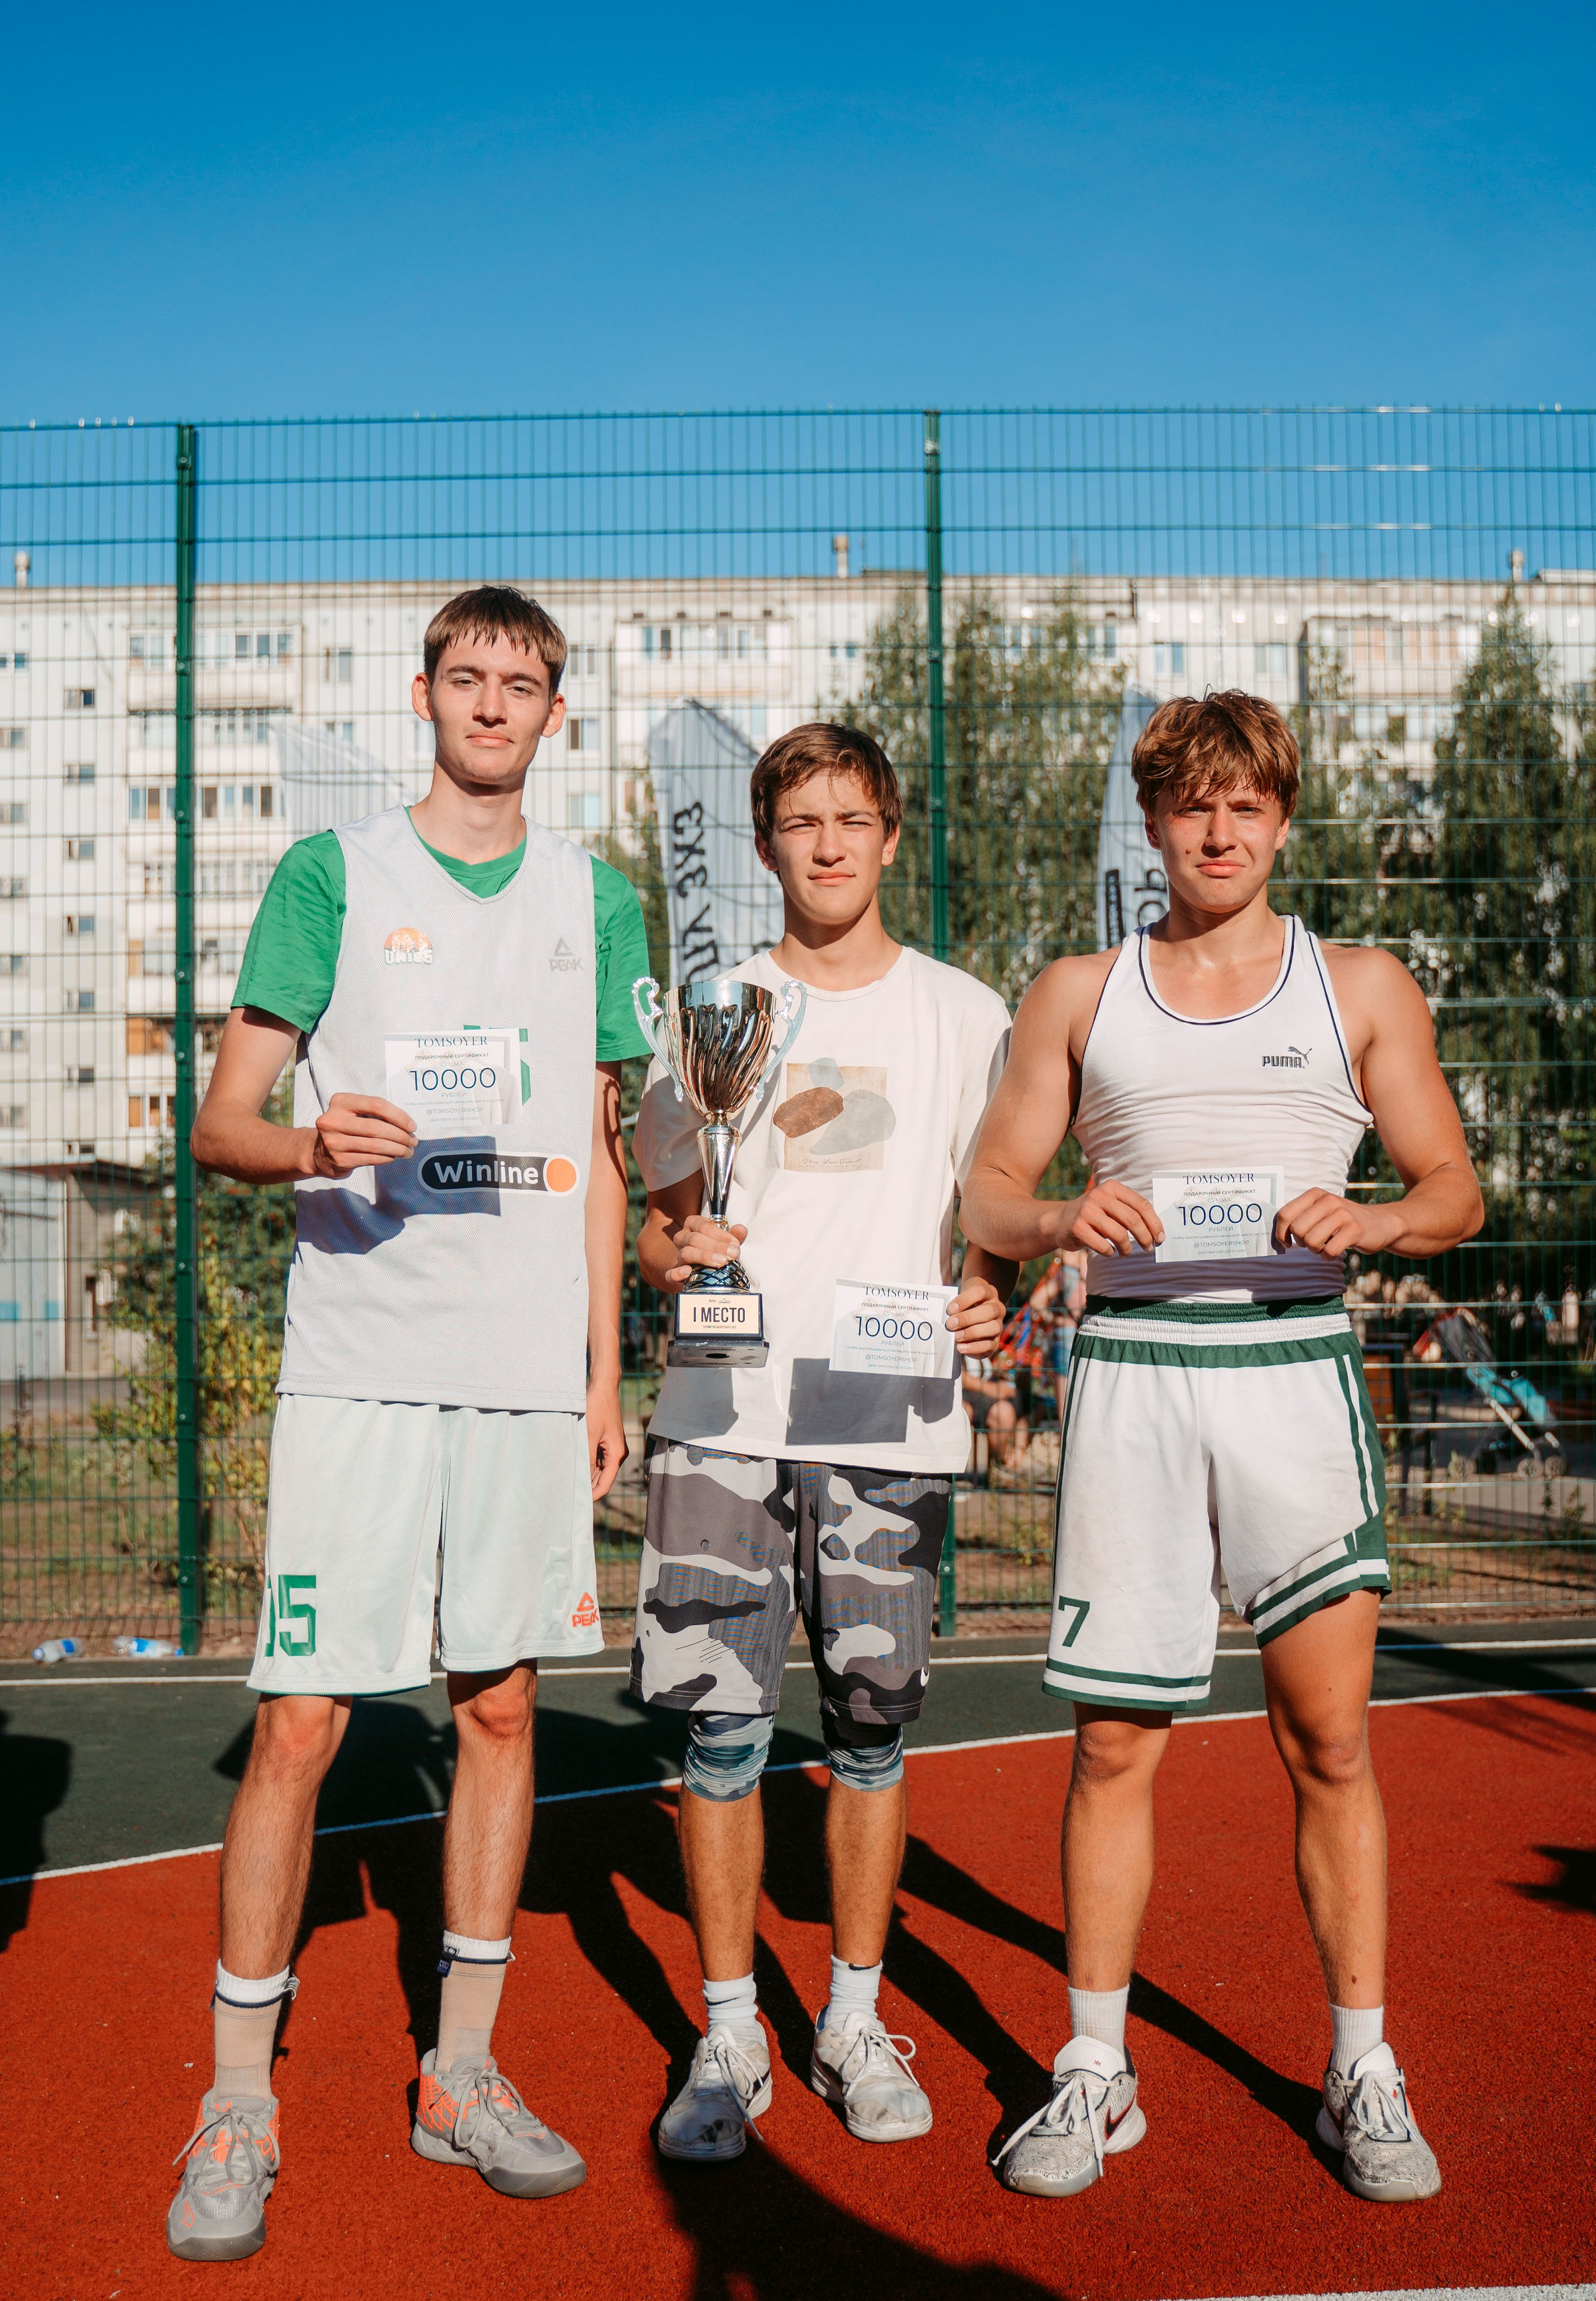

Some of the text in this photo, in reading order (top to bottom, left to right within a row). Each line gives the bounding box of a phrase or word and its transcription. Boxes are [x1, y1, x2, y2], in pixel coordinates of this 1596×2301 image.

[414, 1035, 488, 1048] TOMSOYER
[1262, 1055, 1302, 1068] PUMA
[410, 1067, 496, 1091] 10000
[426, 1107, 483, 1115] @TOMSOYERSHOP
[435, 1160, 539, 1184] Winline
[1183, 1173, 1254, 1184] TOMSOYER
[1178, 1203, 1262, 1226] 10000
[1193, 1239, 1249, 1248] @TOMSOYERSHOP
[863, 1285, 929, 1300] TOMSOYER
[701, 1307, 746, 1323] МЕСТО
[855, 1316, 933, 1341] 10000
[865, 1353, 917, 1364] @TOMSOYERSHOP
[572, 1608, 600, 1628] PEAK
[1058, 1595, 1090, 1648] 7
